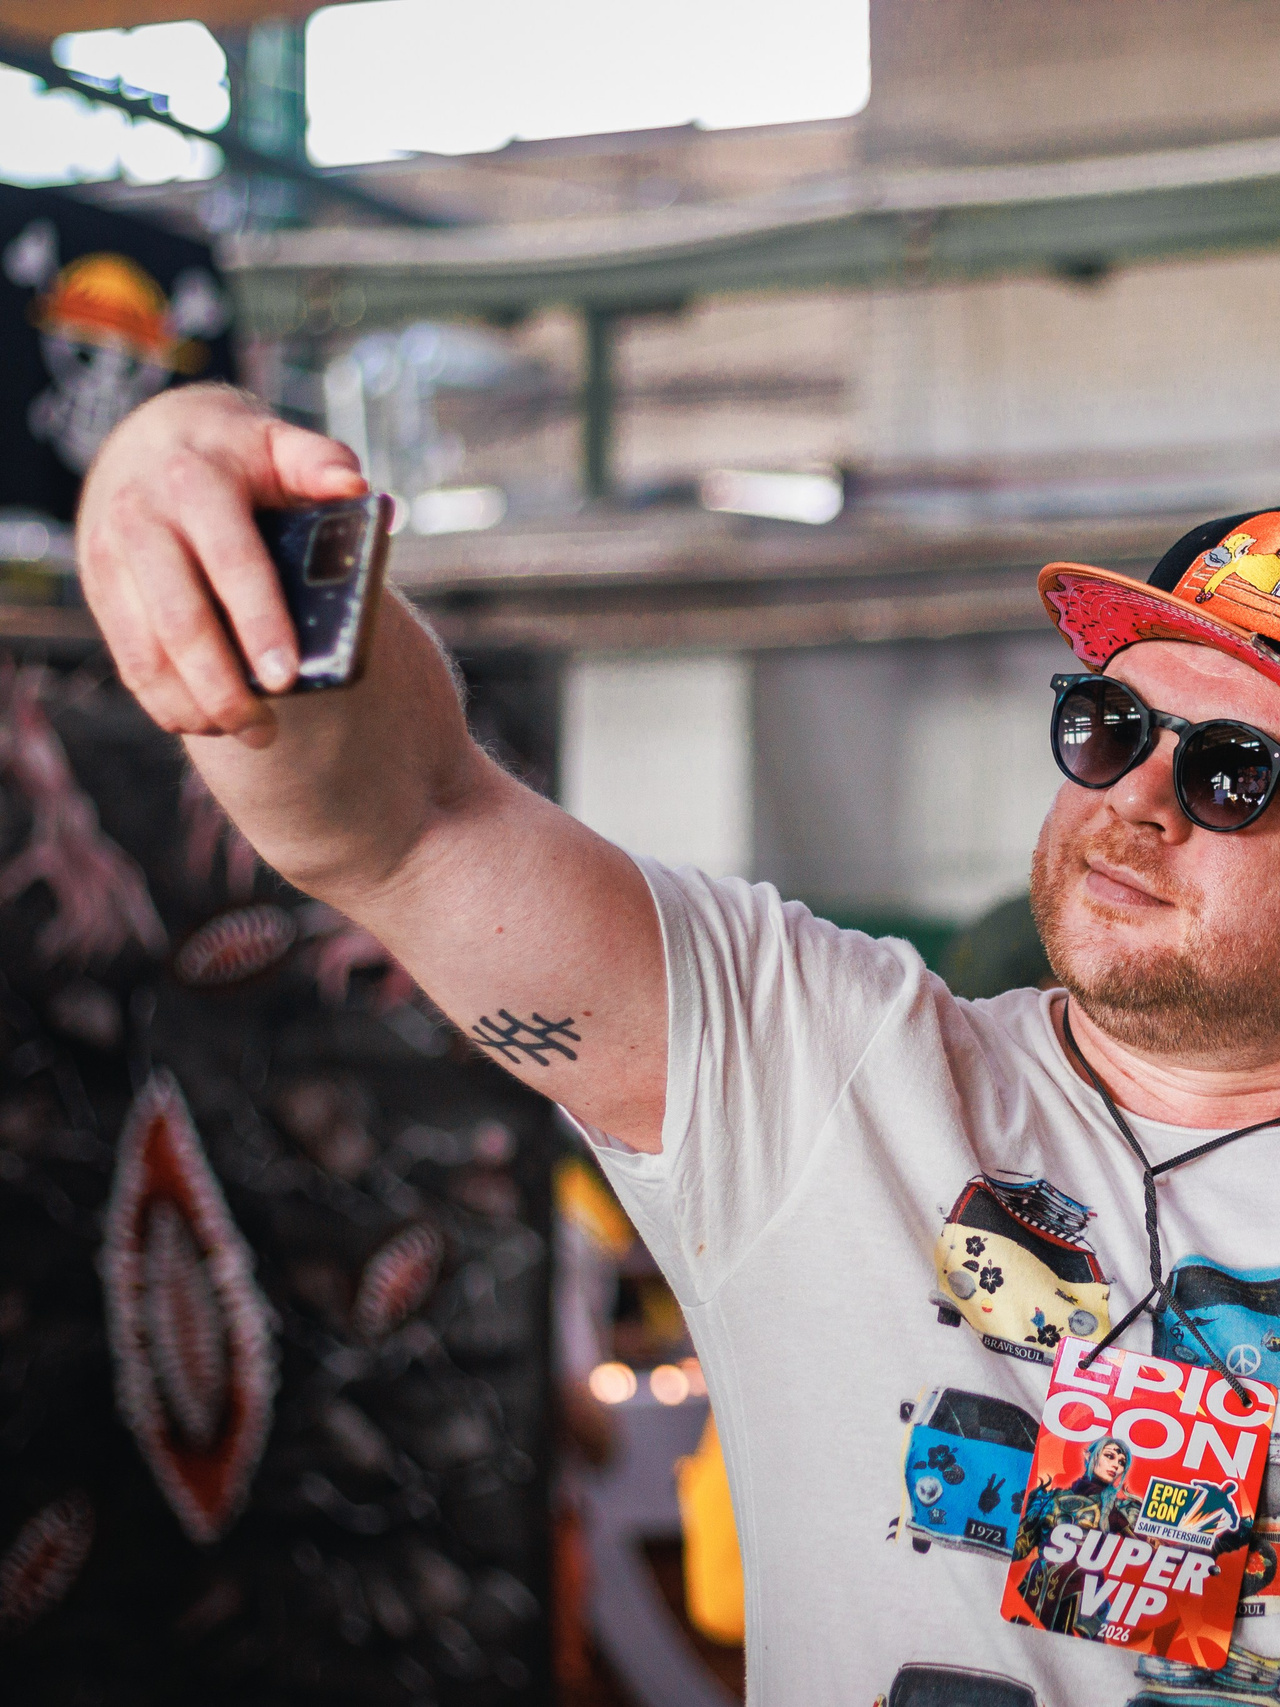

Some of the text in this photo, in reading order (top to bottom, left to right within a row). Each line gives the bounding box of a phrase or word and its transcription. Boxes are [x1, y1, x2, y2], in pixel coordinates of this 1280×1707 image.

[1053, 1338, 1275, 1427] EPIC
[1041, 1391, 1258, 1480] CON
[1151, 1483, 1188, 1507] EPIC
[1146, 1500, 1180, 1523] CON
[969, 1523, 1002, 1542] 1972
[1137, 1521, 1213, 1546] SAINT PETERSBURG
[1043, 1523, 1217, 1596] SUPER
[1079, 1572, 1168, 1627] VIP
[1097, 1622, 1130, 1643] 2026
